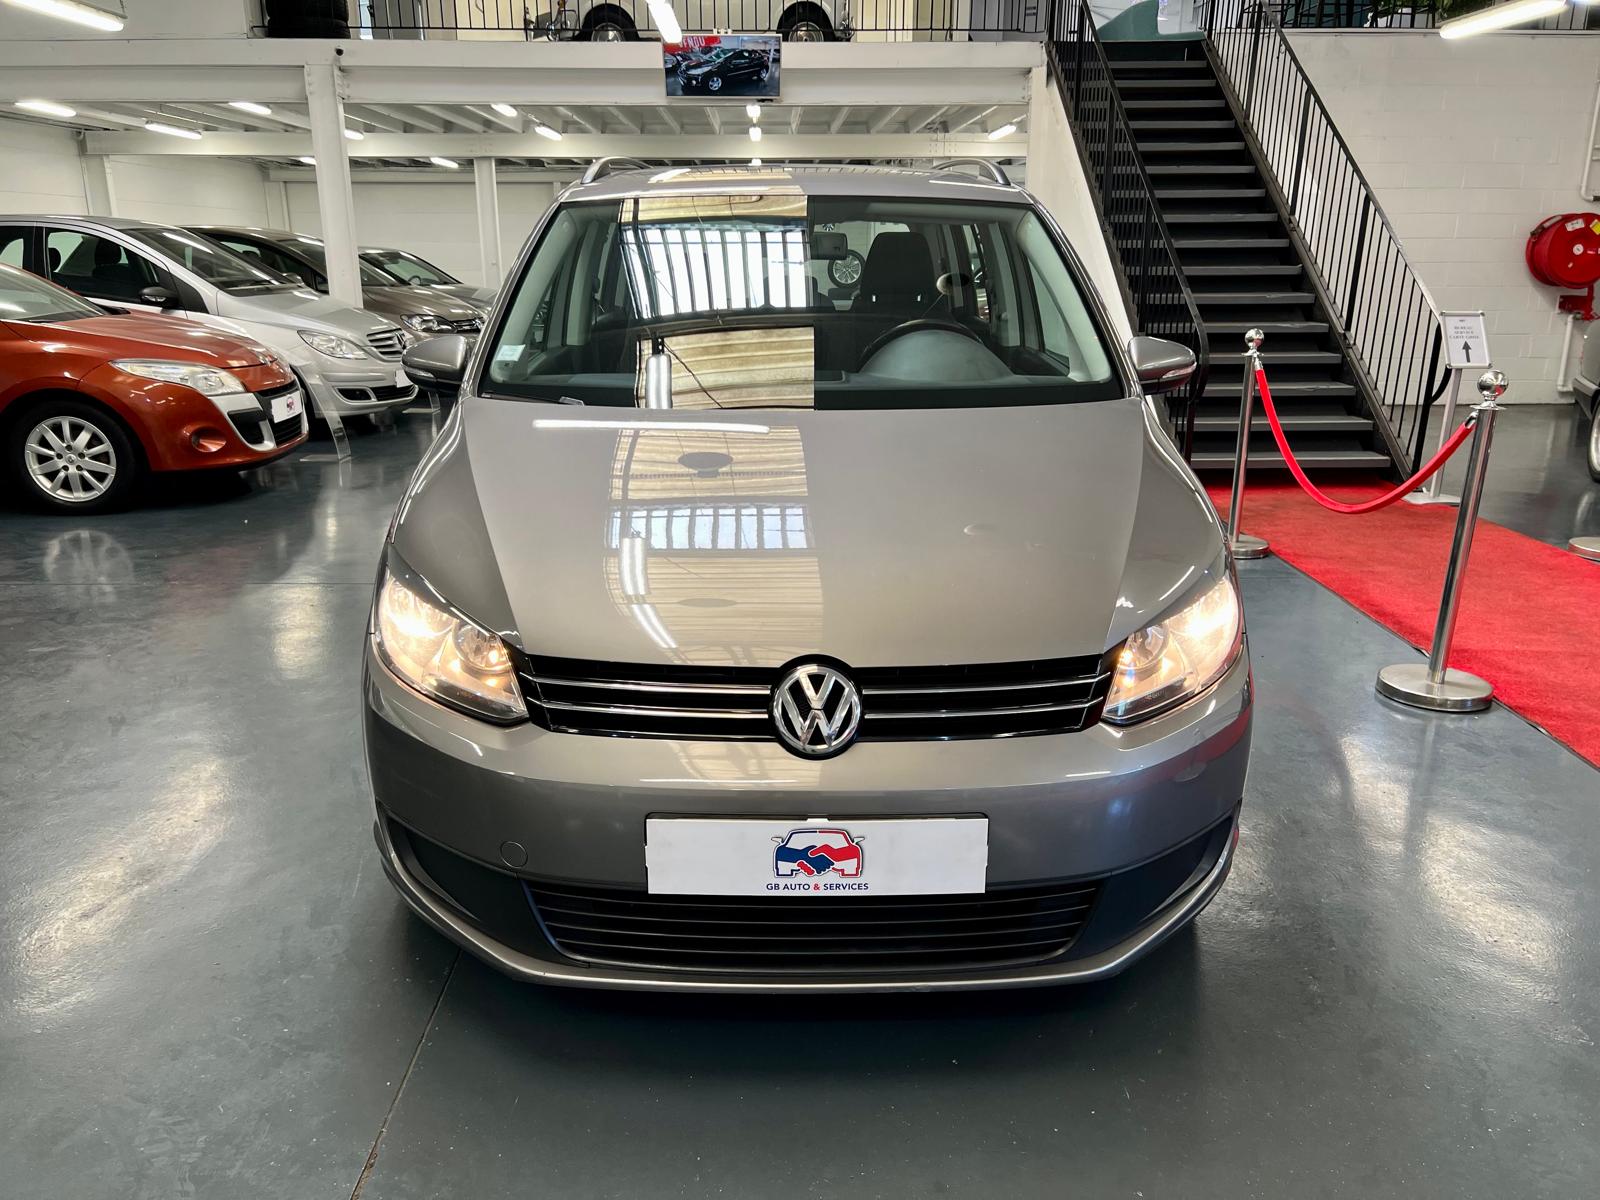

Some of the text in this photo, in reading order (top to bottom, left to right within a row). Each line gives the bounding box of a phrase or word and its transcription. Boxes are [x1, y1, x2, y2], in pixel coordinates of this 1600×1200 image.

[766, 883, 869, 891] GB AUTO & SERVICES
